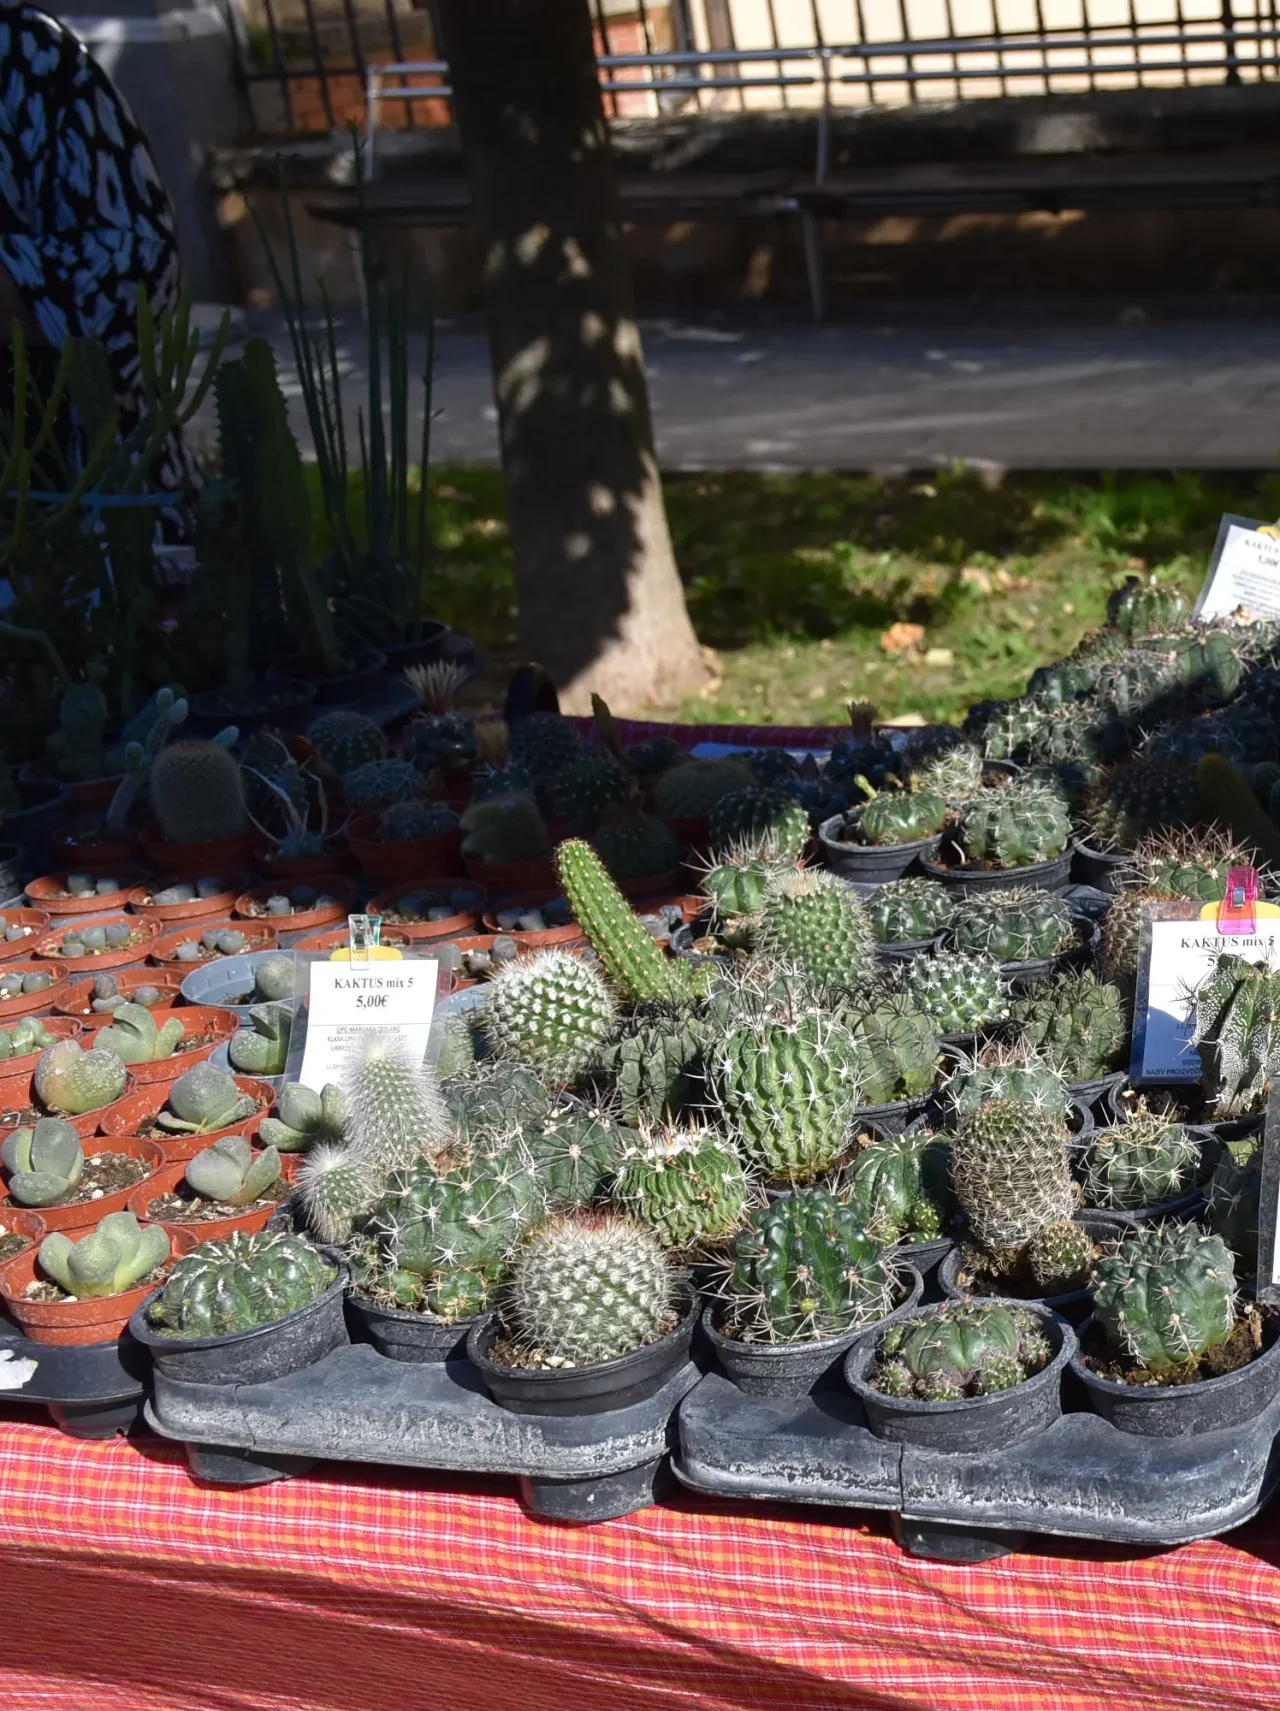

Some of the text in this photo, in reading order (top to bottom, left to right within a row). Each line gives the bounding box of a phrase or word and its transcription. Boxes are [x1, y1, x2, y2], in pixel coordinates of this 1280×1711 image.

[1181, 936, 1238, 949] KAKTUS
[1243, 936, 1264, 947] mix
[334, 978, 413, 988] KAKTUS mix 5
[356, 995, 389, 1009] 5,00€
